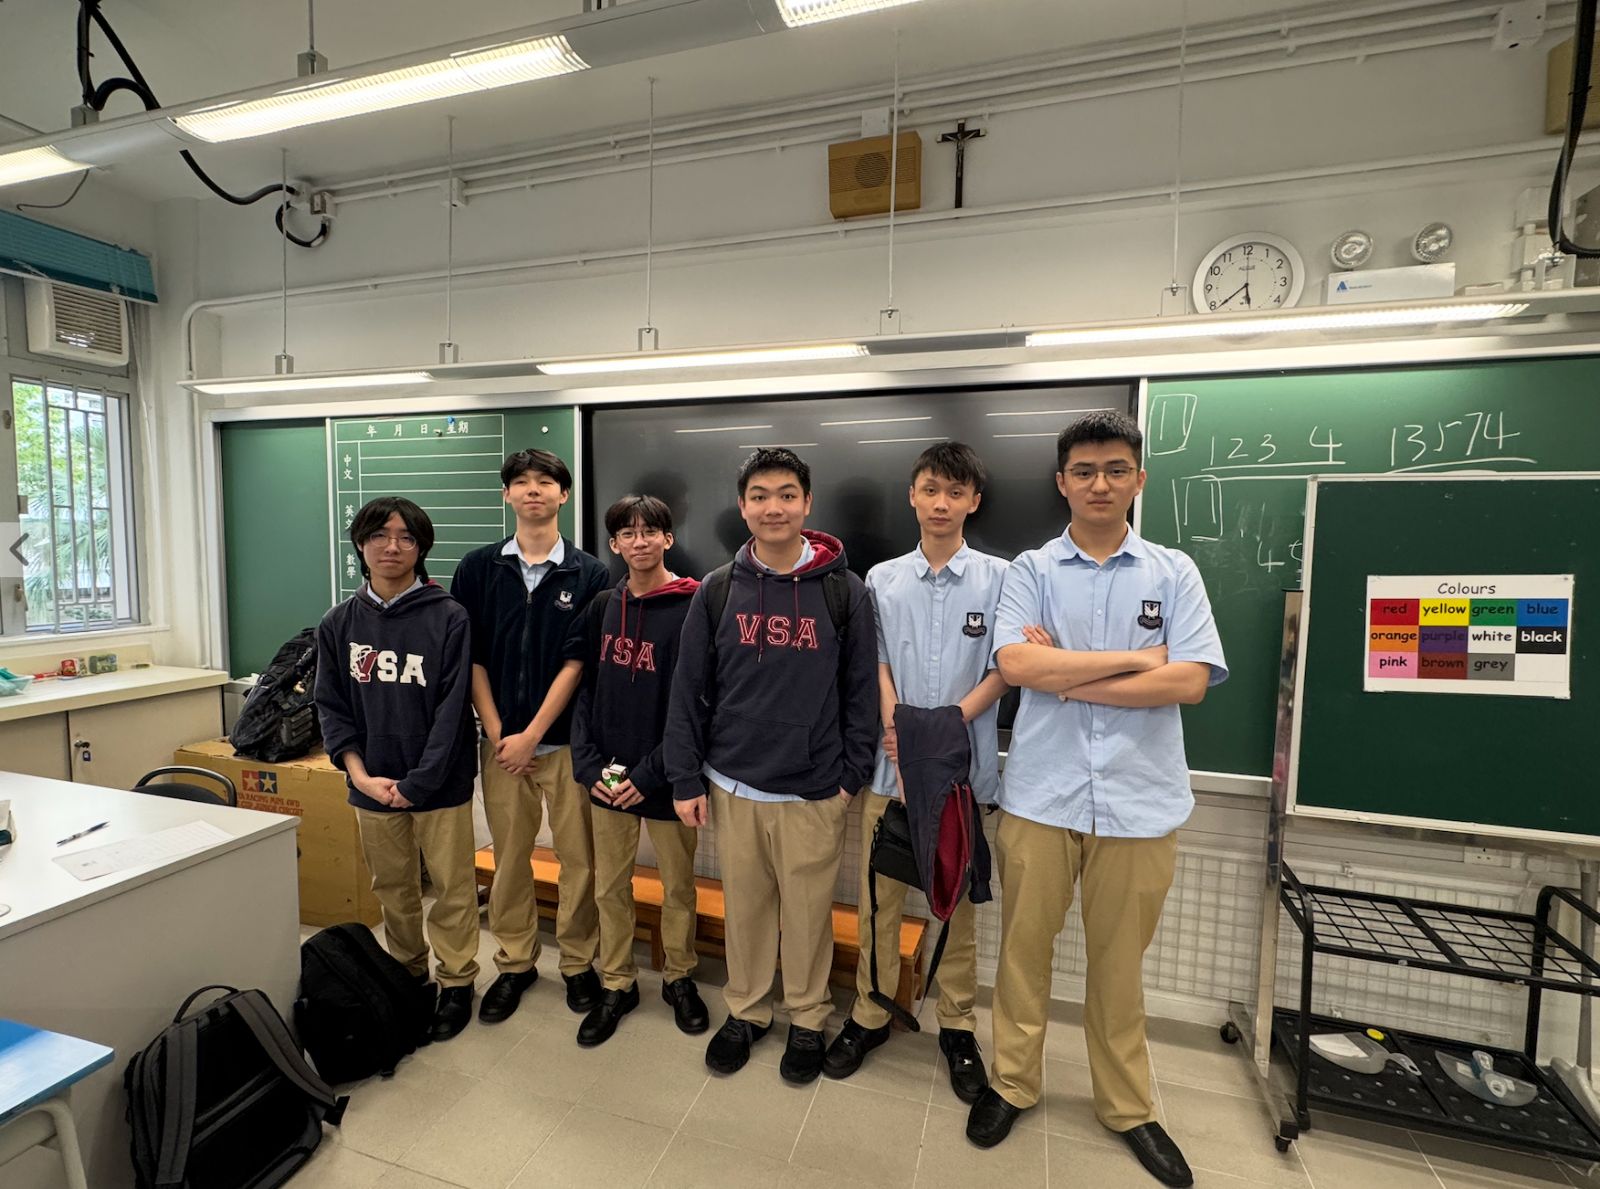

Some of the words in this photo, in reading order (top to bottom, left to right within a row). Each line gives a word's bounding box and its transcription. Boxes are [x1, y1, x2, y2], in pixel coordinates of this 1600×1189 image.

[1243, 245, 1254, 255] 12
[1222, 253, 1232, 263] 11
[1276, 259, 1284, 269] 2
[1210, 266, 1220, 276] 10
[1280, 277, 1287, 287] 3
[1205, 284, 1213, 294] 9
[1273, 294, 1281, 303] 4
[1209, 301, 1217, 311] 8
[366, 424, 377, 438] 年
[394, 423, 402, 436] 月
[420, 423, 428, 434] 日
[1391, 411, 1521, 467] 13574
[343, 454, 354, 480] 中文
[1437, 582, 1496, 595] Colours
[1383, 603, 1408, 614] red
[1422, 603, 1467, 617] yellow
[1471, 604, 1515, 617] green
[1526, 603, 1559, 615] blue
[736, 613, 818, 649] VSA
[1370, 631, 1417, 643] orange
[1422, 628, 1464, 642] purple
[1471, 630, 1512, 642] white
[1520, 631, 1562, 643] black
[1379, 655, 1408, 669] pink
[1421, 656, 1464, 668] brown
[1473, 660, 1508, 672] grey
